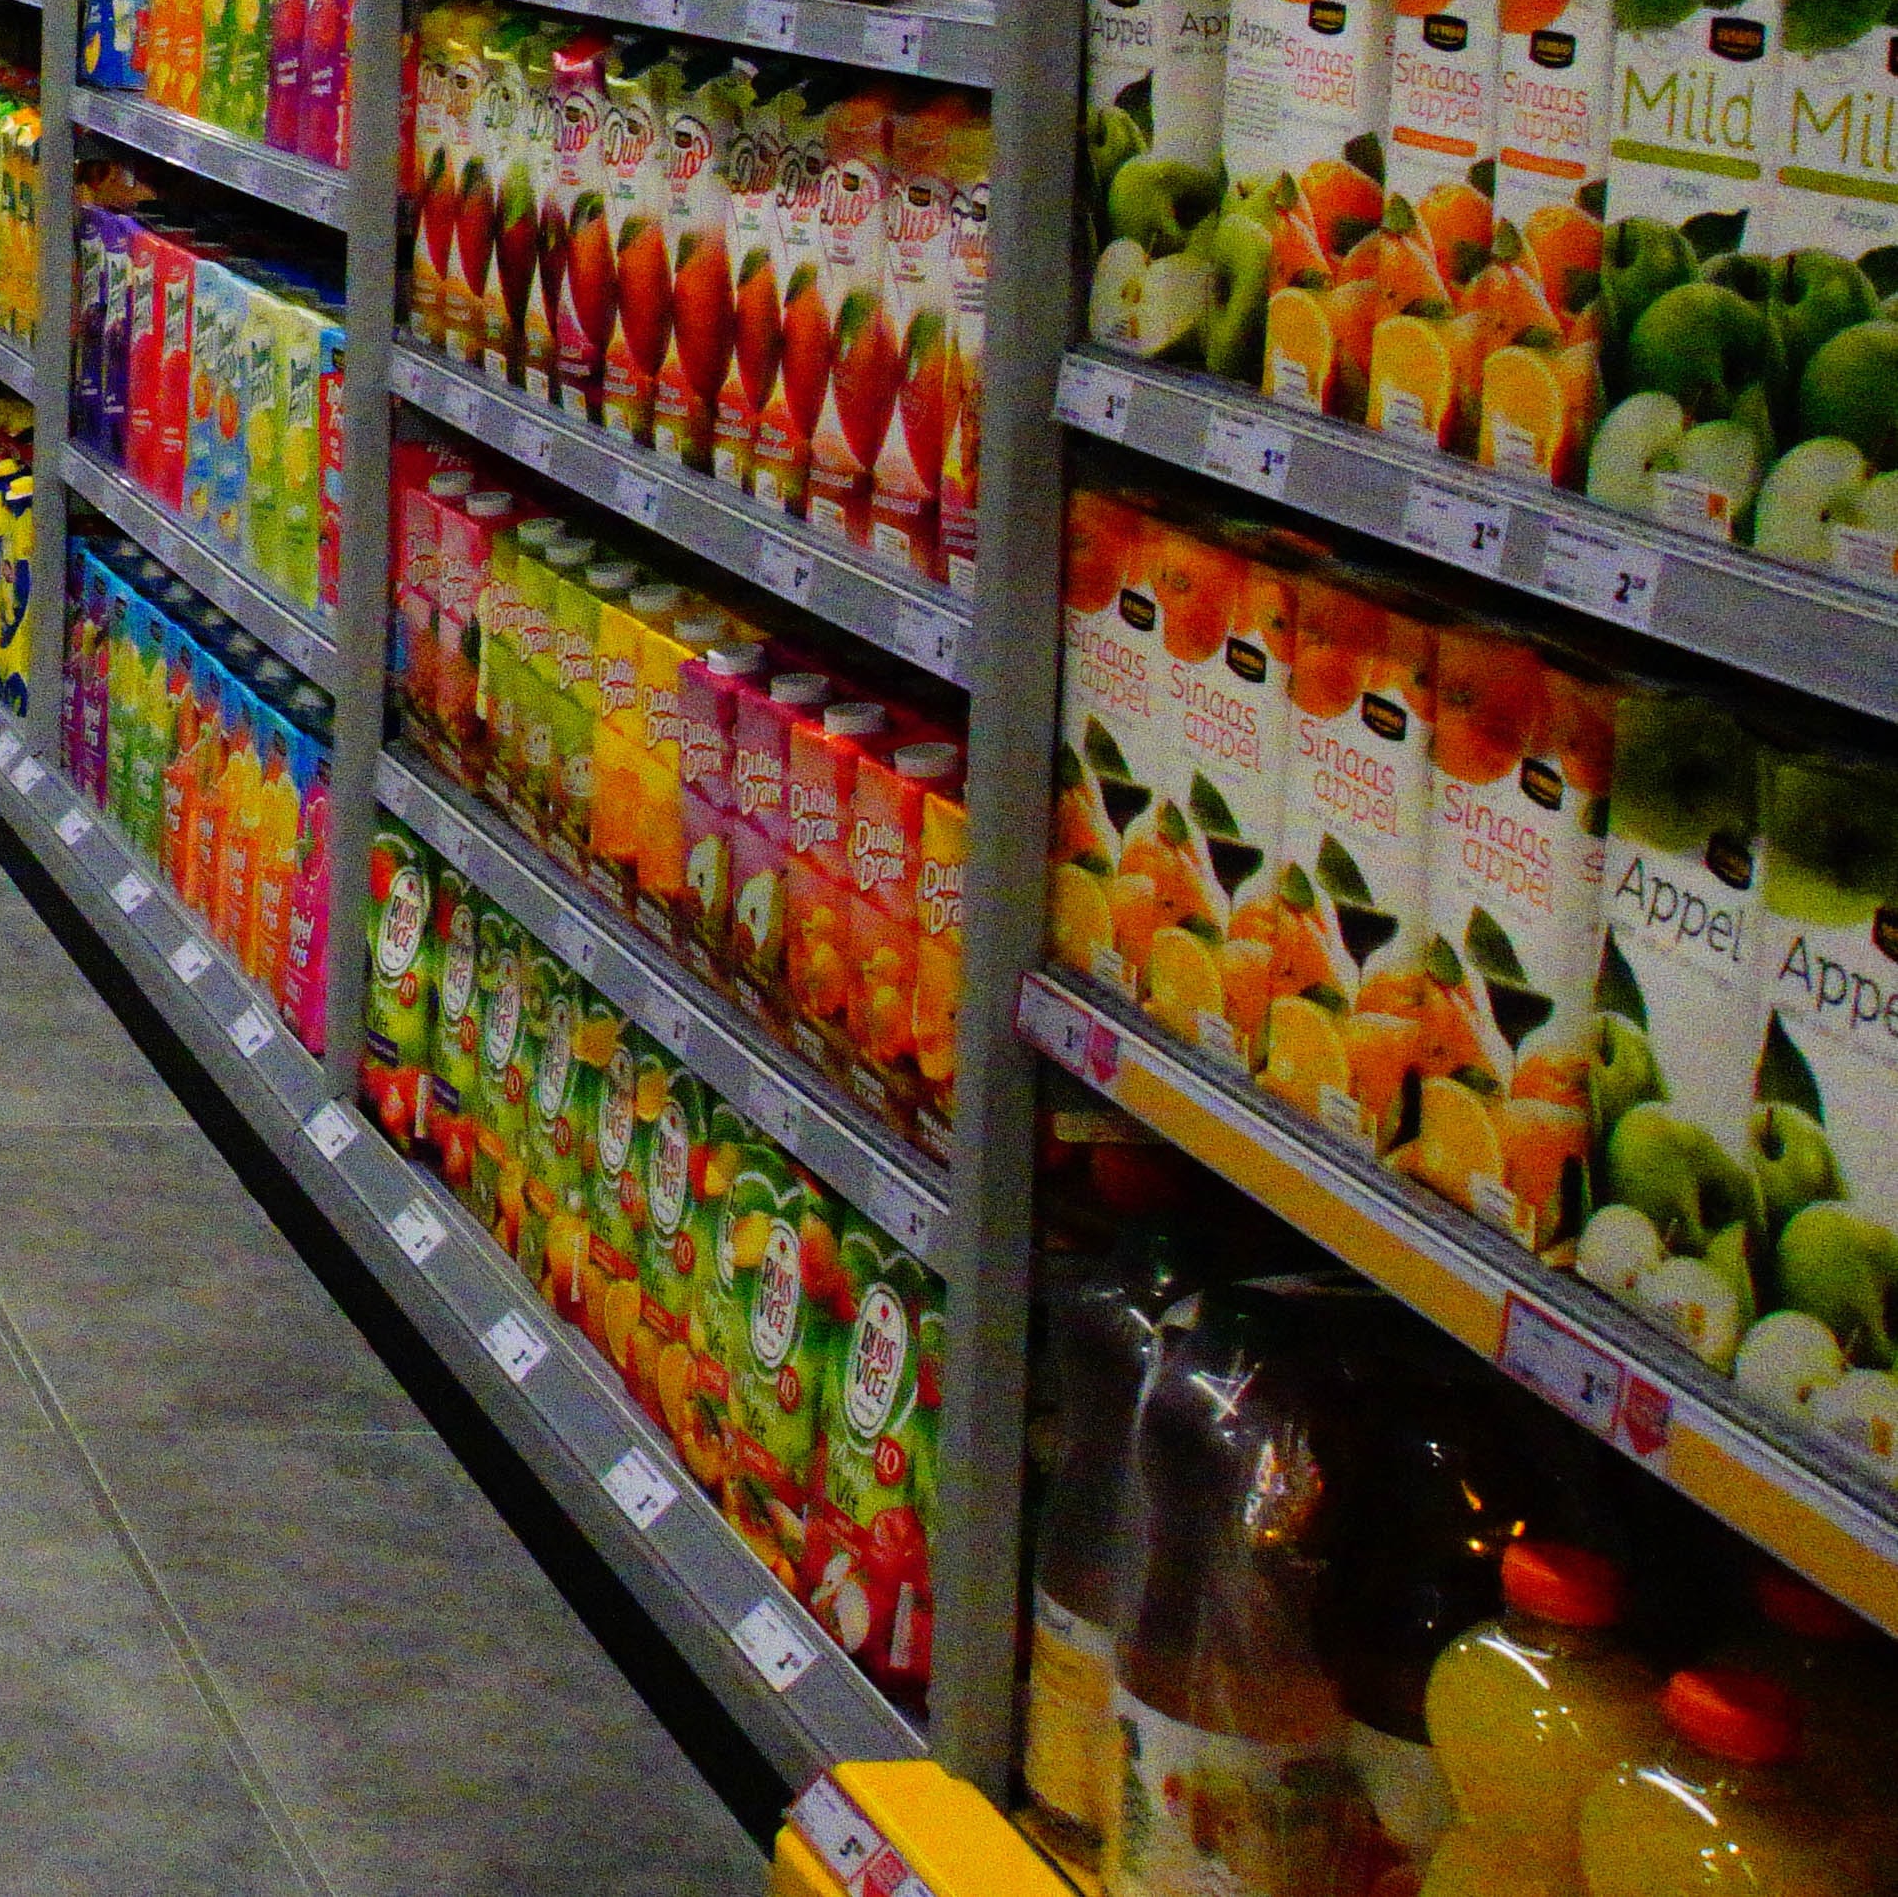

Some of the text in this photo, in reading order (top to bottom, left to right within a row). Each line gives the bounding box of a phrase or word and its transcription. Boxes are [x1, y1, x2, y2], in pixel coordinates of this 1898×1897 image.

[1090, 9, 1154, 49] Appel
[1236, 18, 1284, 52] Appe
[1286, 36, 1355, 81] Sinaas
[1296, 70, 1357, 111] appel
[1392, 51, 1482, 101] Sinaas
[1503, 71, 1587, 119] Sinaas
[1622, 67, 1756, 152] Mild
[1515, 109, 1592, 150] appel
[1792, 88, 1898, 175] Mil
[1068, 615, 1149, 685] Sinaas
[1078, 661, 1151, 720] appel
[1169, 662, 1258, 735] Sinaas
[1183, 708, 1262, 777] appel
[1297, 717, 1398, 795] Sinaas
[1313, 767, 1400, 840] appel
[1444, 783, 1553, 869] Sinaas
[1462, 838, 1553, 915] appel
[1616, 855, 1745, 963] Appel
[926, 899, 963, 936] Dra
[1779, 936, 1898, 1031] Appe
[855, 1322, 908, 1366] ROOS
